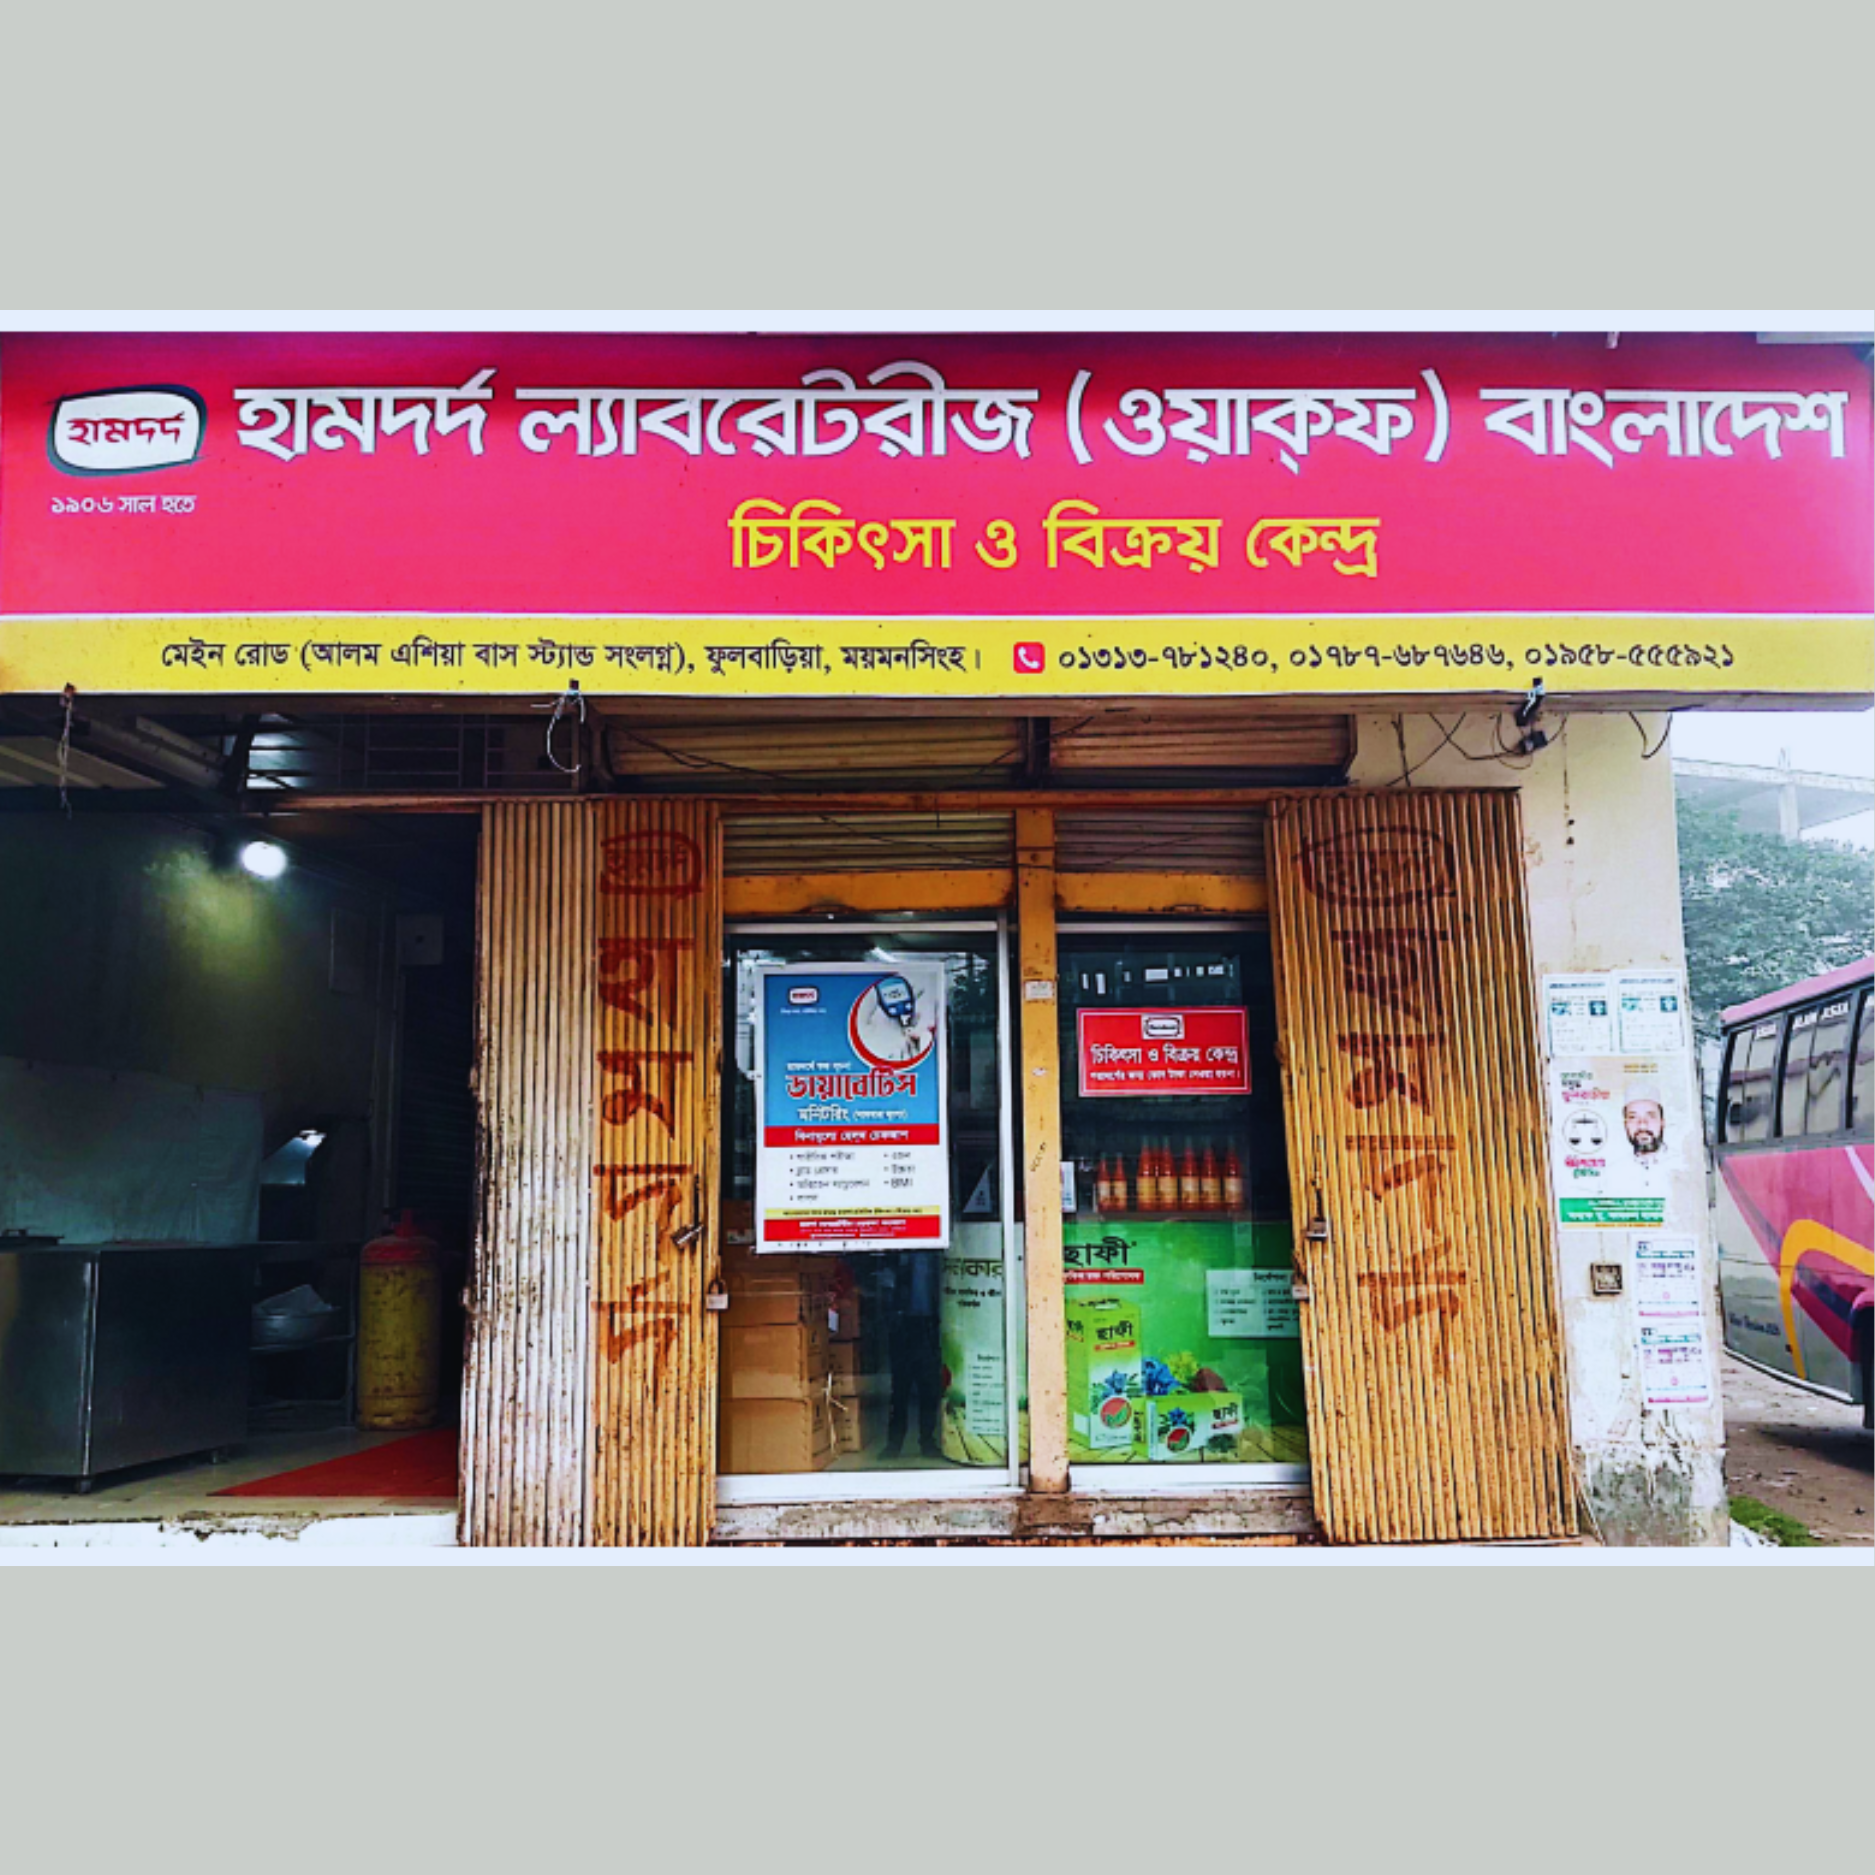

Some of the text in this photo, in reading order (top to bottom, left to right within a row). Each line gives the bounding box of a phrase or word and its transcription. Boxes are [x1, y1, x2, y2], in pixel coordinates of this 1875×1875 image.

[66, 411, 186, 447] হামদর্দ
[234, 367, 498, 461] হামদর্দ
[515, 360, 1039, 459] ল্যাবরেটরীজ
[1480, 388, 1849, 469] বাংলাদেশ
[51, 495, 198, 514] ১৯০৬ সাল হতে
[728, 498, 1381, 578] চিকিৎসা ও বিক্রয় কেন্দ্র
[161, 637, 227, 669] মেইন
[234, 642, 291, 668] রোড
[300, 639, 383, 672] (আলম
[391, 634, 466, 668] এশিয়া
[473, 643, 518, 668] বাস
[528, 638, 595, 668] স্ট্যান্ড
[703, 637, 832, 675] ফুলবাড়িয়া,
[1058, 643, 1736, 674] ০১৩১৩-৭৮১২৪০, ০১৭৮৭-৬৮৭৬৪৬, ০১৯৫৮-৫৫৫৯২১
[786, 1065, 918, 1101] ডায়াবেটিস
